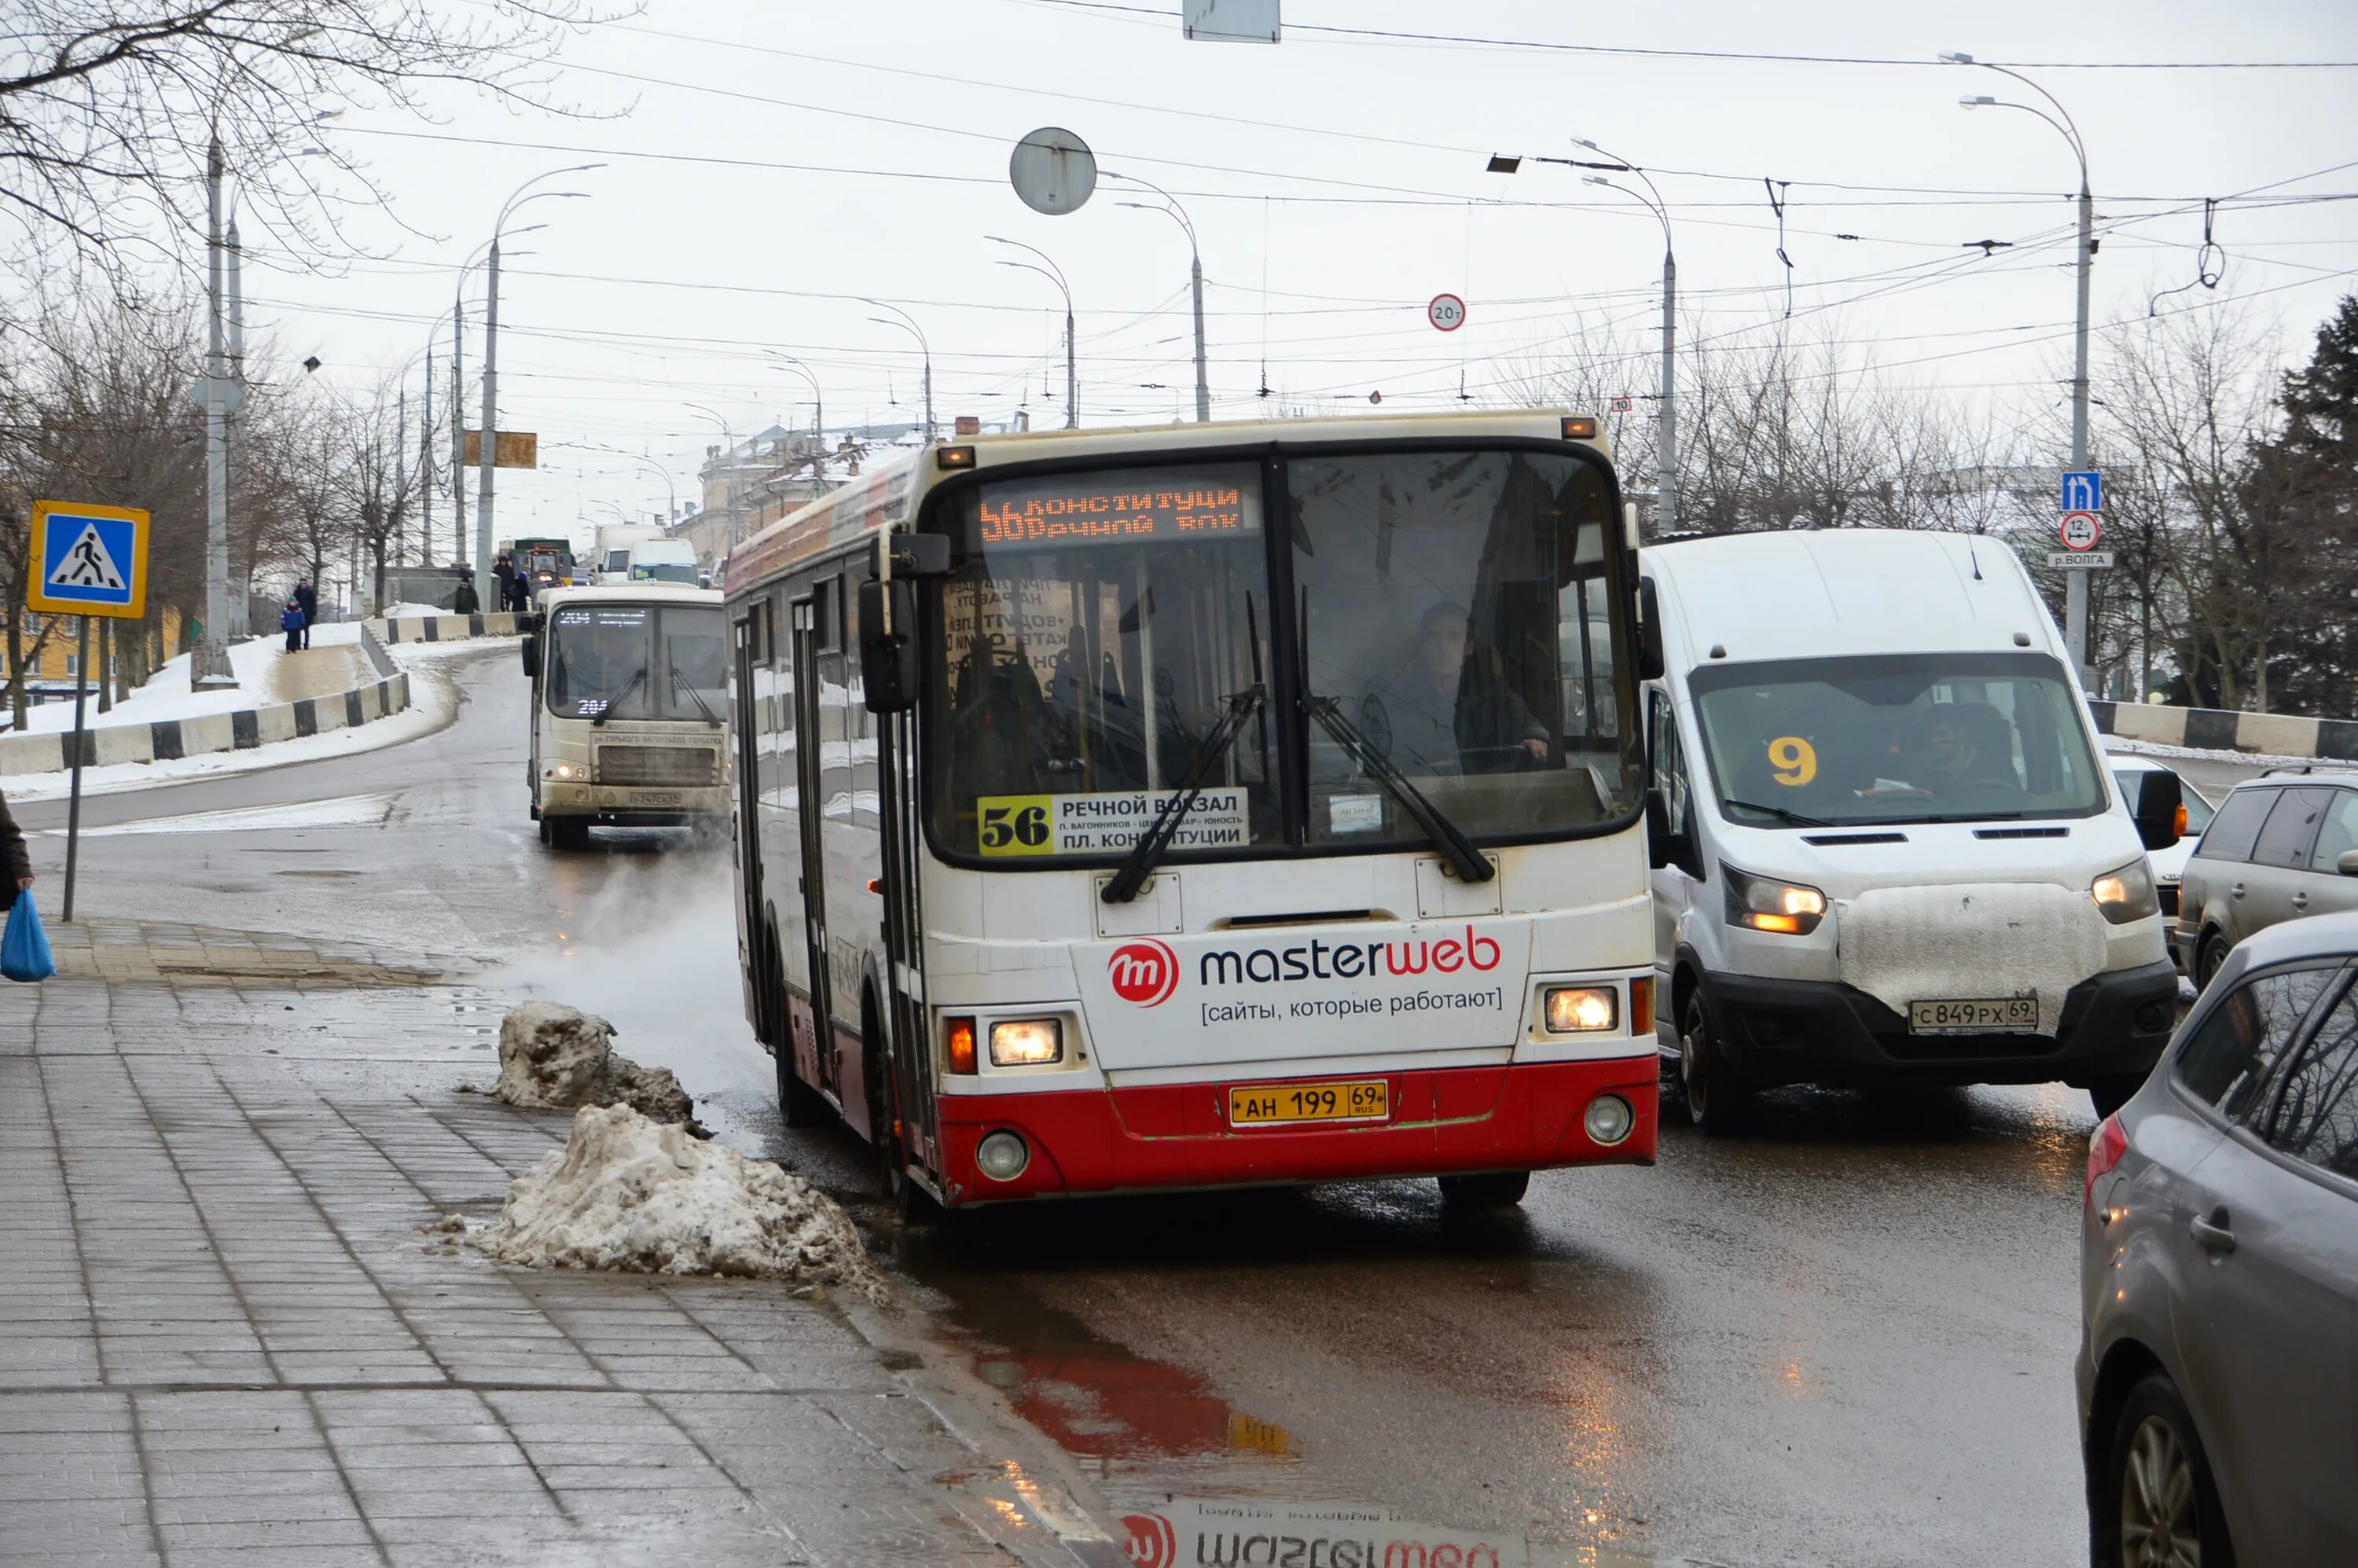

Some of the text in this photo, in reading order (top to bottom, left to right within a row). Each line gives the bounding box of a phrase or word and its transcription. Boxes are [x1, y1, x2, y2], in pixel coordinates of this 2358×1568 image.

[1615, 400, 1628, 409] 10
[980, 503, 1024, 542] 56
[2055, 555, 2106, 567] р.ВОЛГА
[1768, 736, 1817, 786] 9
[1063, 795, 1148, 818] РЕЧНОЙ
[982, 806, 1051, 849] 56
[1071, 820, 1131, 831] ВАГОННИКОВ
[1139, 818, 1196, 828] ЦЕНРОВАР
[1203, 816, 1243, 826] ЮНОСТЬ
[1063, 835, 1096, 850] ПЛ.
[1201, 924, 1500, 986] masterweb
[1202, 988, 1503, 1026] [сайты, которые работают]
[2009, 1002, 2029, 1017] 69
[1246, 1086, 1376, 1118] АН 199 69
